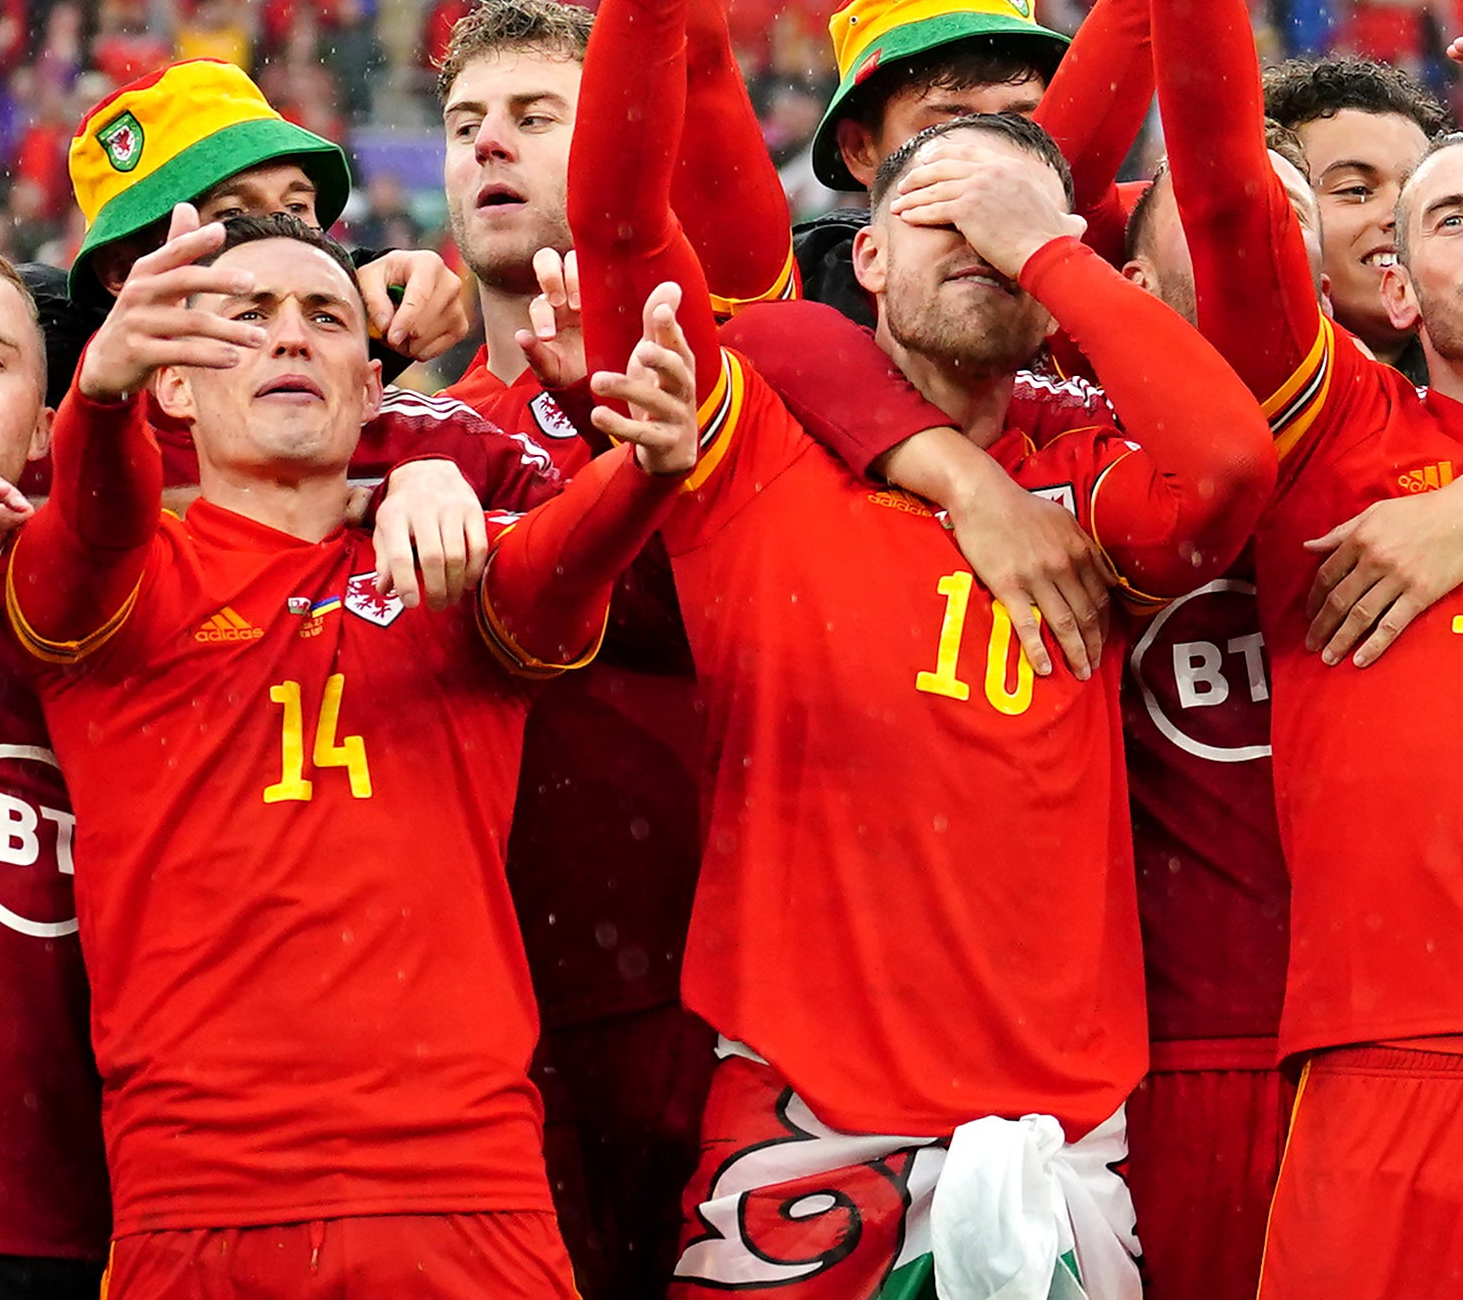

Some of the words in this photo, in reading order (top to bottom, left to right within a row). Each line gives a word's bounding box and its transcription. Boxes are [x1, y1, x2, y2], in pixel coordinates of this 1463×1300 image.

[195, 626, 264, 642] adidas
[916, 571, 1041, 715] 10
[1173, 632, 1270, 708] BT
[263, 673, 373, 803] 14
